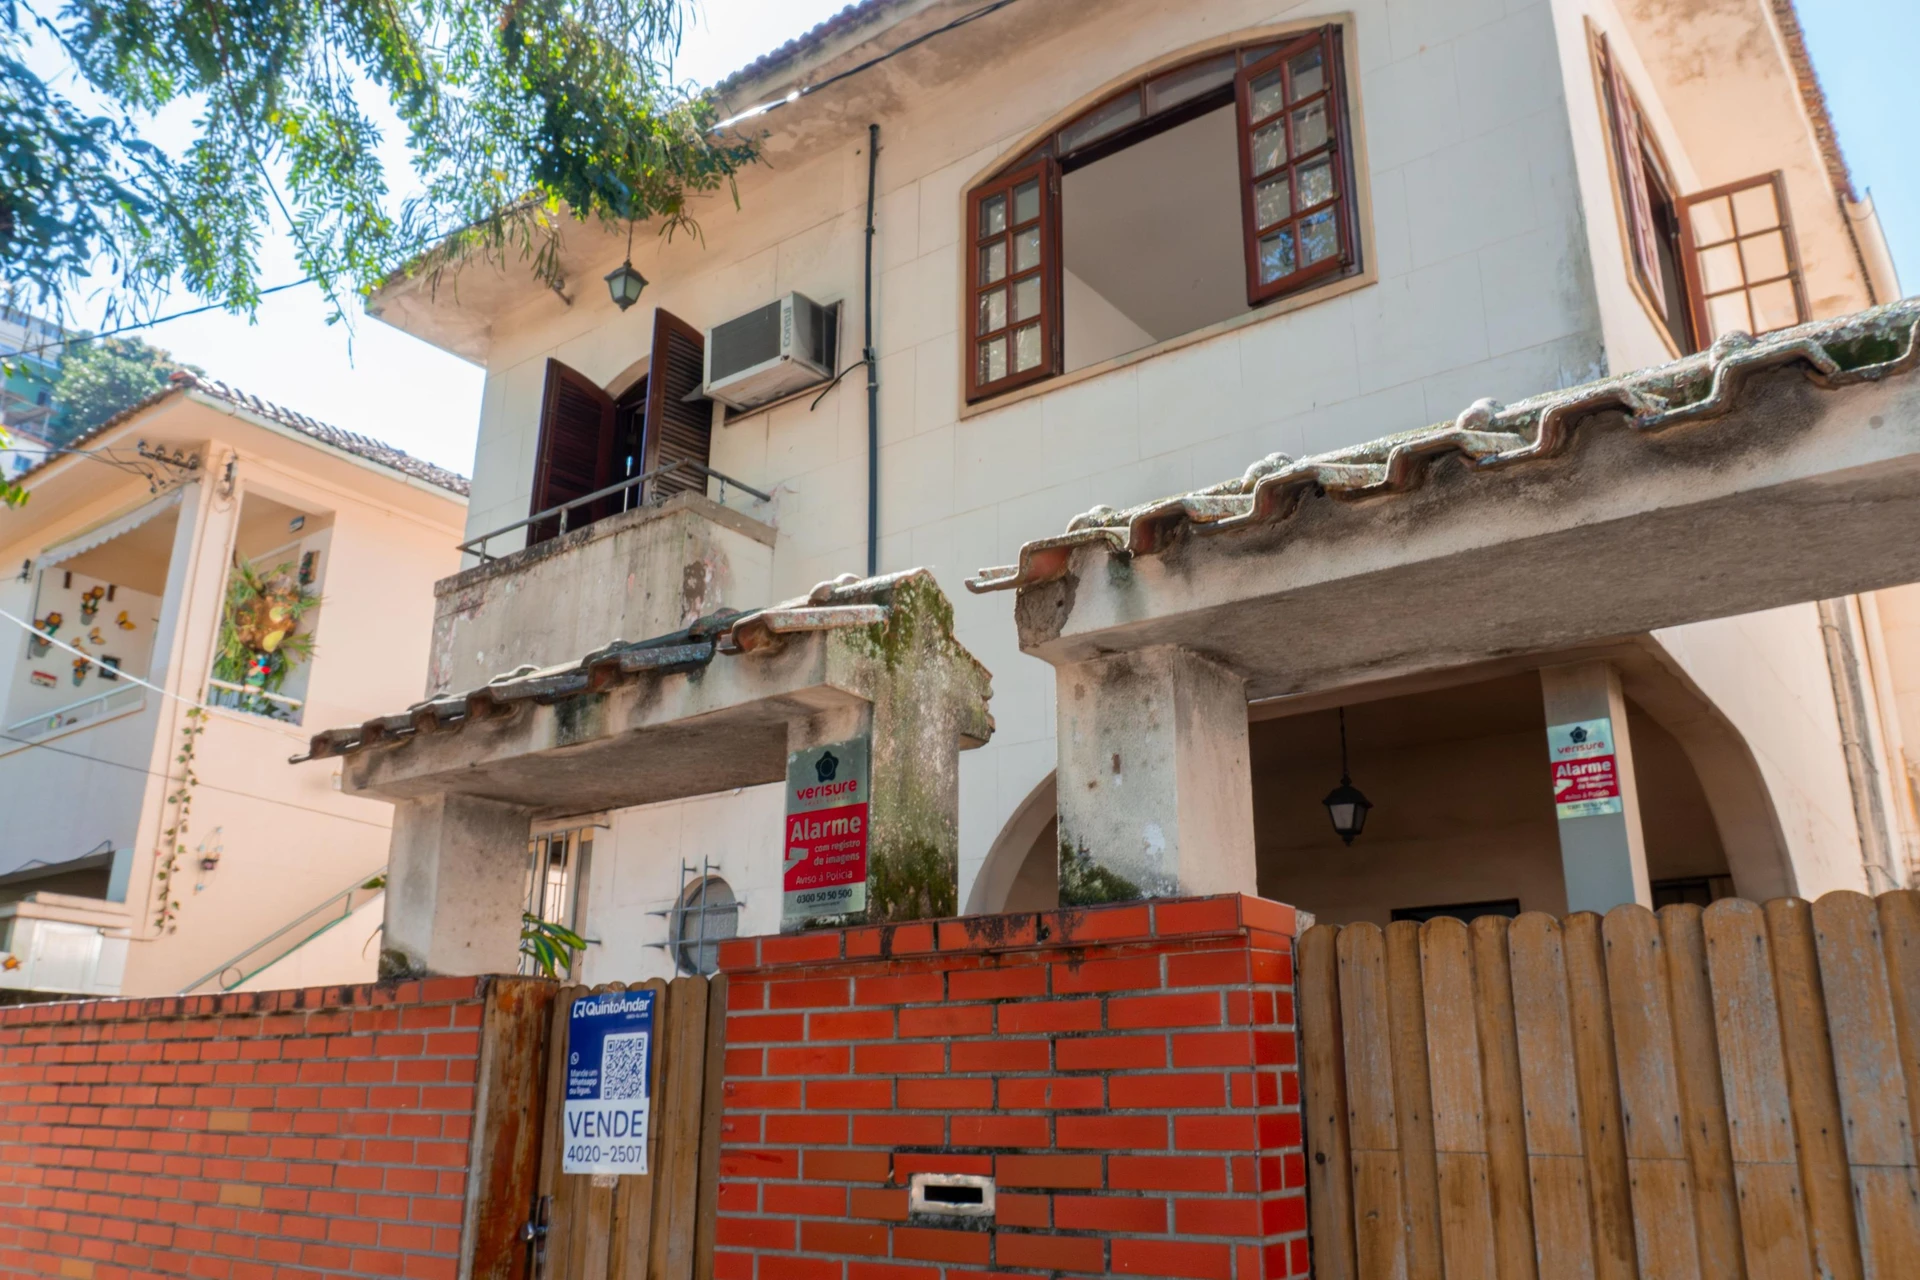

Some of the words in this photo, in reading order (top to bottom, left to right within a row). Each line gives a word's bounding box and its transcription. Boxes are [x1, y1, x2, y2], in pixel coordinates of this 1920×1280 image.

[1557, 741, 1605, 755] verisure
[1556, 761, 1611, 778] Alarme
[796, 779, 857, 801] verisure
[790, 816, 861, 842] Alarme
[814, 844, 830, 853] com
[831, 839, 861, 852] registro
[813, 856, 824, 866] de
[825, 852, 860, 865] imagens
[796, 874, 817, 885] Aviso
[796, 893, 816, 904] 0300
[816, 891, 827, 901] 50
[827, 890, 837, 900] 50
[838, 888, 853, 899] 500
[585, 997, 650, 1016] QuintoAndar
[568, 1110, 644, 1138] VENDE
[567, 1145, 642, 1163] 4020-2507
